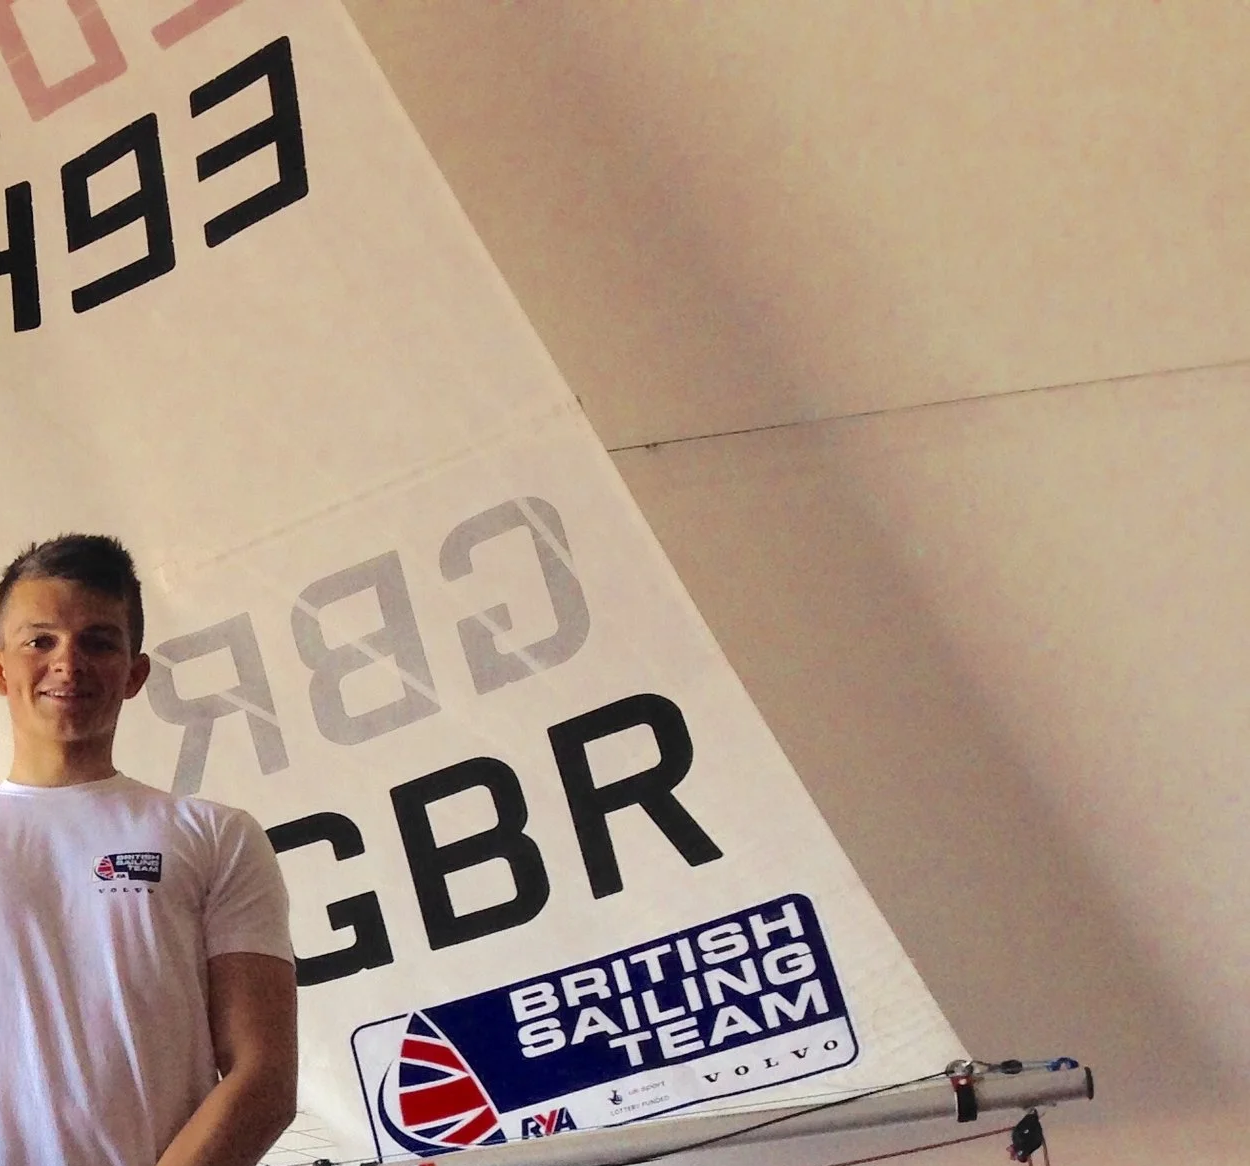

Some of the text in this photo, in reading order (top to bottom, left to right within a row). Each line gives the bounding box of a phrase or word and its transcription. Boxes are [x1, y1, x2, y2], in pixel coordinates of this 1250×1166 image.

[263, 692, 724, 987] GBR
[508, 901, 806, 1024] BRITISH
[516, 941, 817, 1059] SAILING
[608, 978, 830, 1068] TEAM
[703, 1038, 840, 1084] VOLVO
[521, 1106, 578, 1140] RYA
